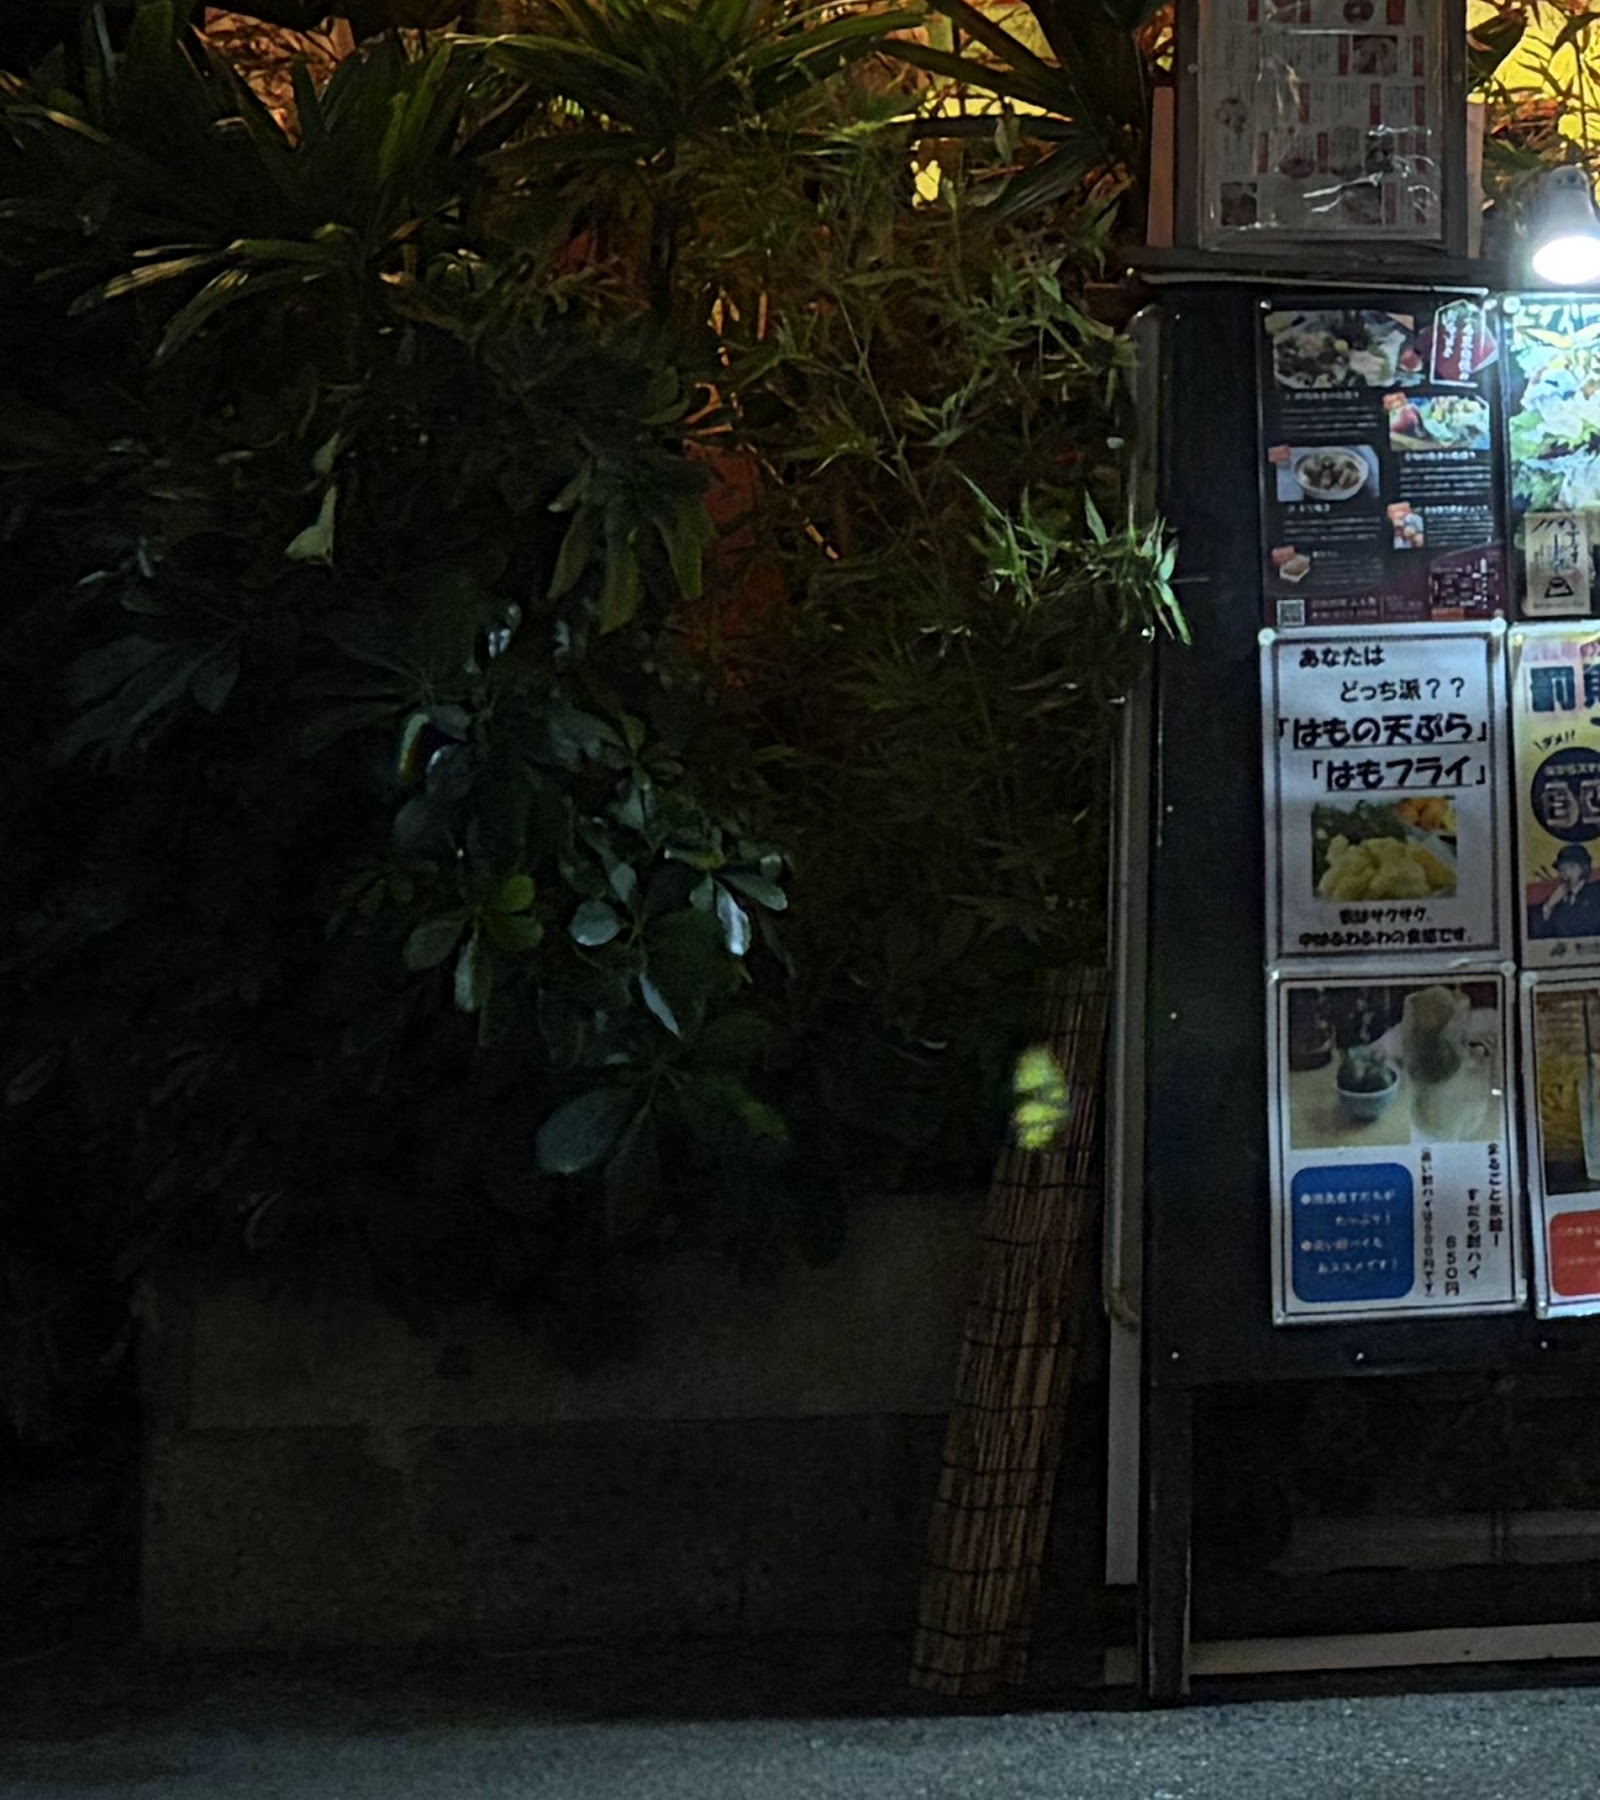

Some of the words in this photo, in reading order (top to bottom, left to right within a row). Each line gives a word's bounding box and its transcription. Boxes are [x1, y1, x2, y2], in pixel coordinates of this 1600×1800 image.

[1299, 646, 1386, 668] あなたは
[1340, 676, 1466, 702] どっち派？？
[1279, 713, 1488, 747] 「はもの天ぷら」
[1312, 755, 1487, 790] 「はもフライ」
